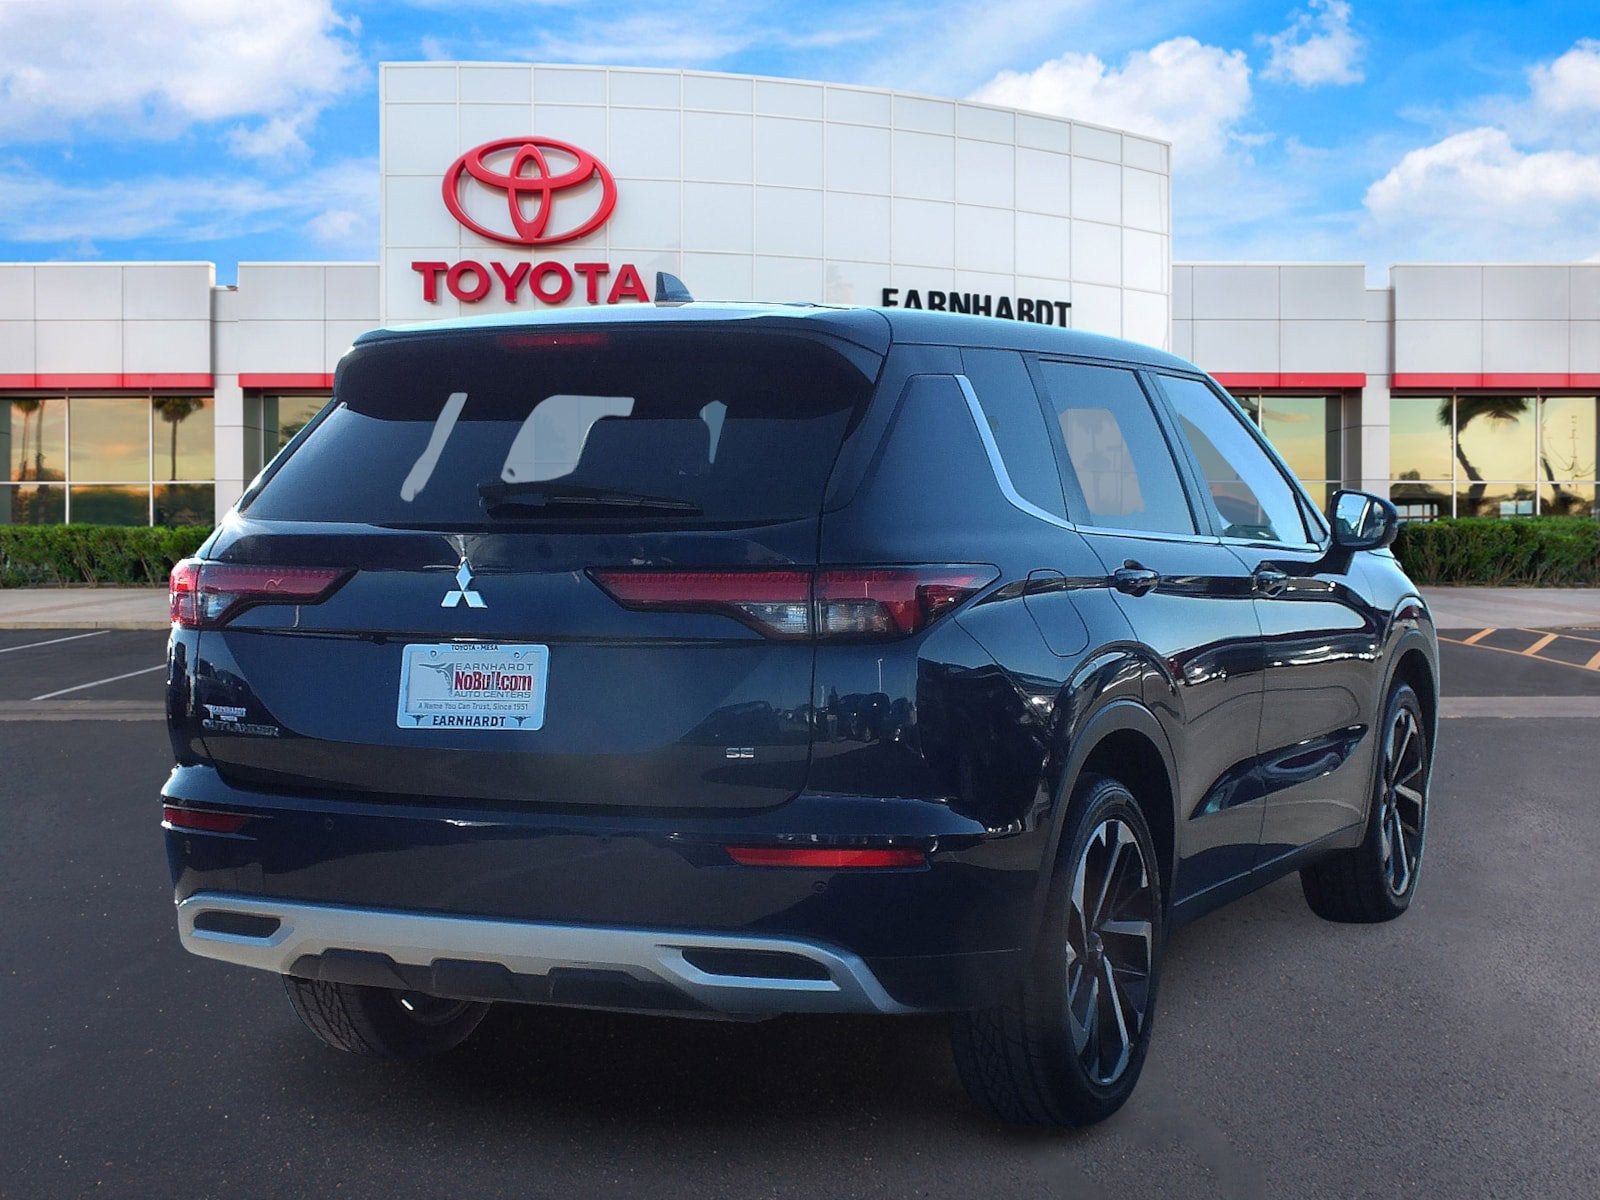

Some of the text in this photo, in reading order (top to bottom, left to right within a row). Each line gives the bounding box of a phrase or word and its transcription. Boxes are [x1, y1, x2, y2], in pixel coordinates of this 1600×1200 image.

[411, 260, 650, 304] TOYOTA
[882, 288, 1072, 328] EARNHARDT
[455, 663, 533, 671] EARNHARDT
[483, 691, 531, 699] CENTERS
[493, 703, 512, 711] Since
[433, 716, 506, 727] EARNHARDT
[726, 747, 755, 759] SE
